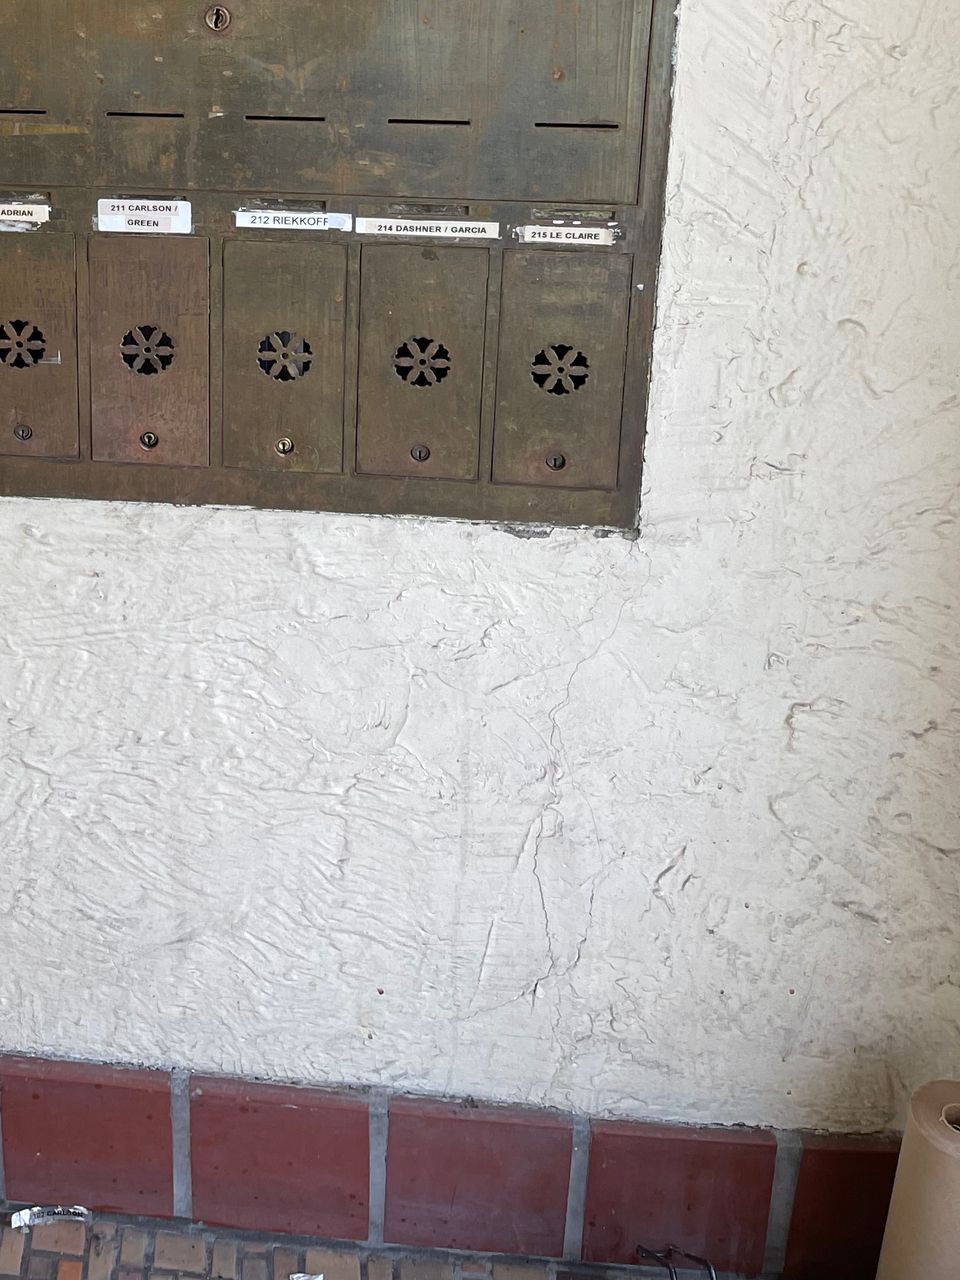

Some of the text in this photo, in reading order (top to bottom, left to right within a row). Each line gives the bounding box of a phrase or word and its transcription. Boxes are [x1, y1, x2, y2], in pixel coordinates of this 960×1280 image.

[1, 208, 34, 217] ADRIAN
[111, 204, 126, 212] 211
[129, 204, 172, 213] CARLSON
[127, 218, 159, 228] GREEN
[250, 215, 329, 226] 212 RIEKKOFF
[377, 224, 393, 232] 214
[395, 224, 442, 234] DASHNER
[451, 225, 487, 234] GARCIA
[531, 230, 600, 240] 215 LE CLAIRE
